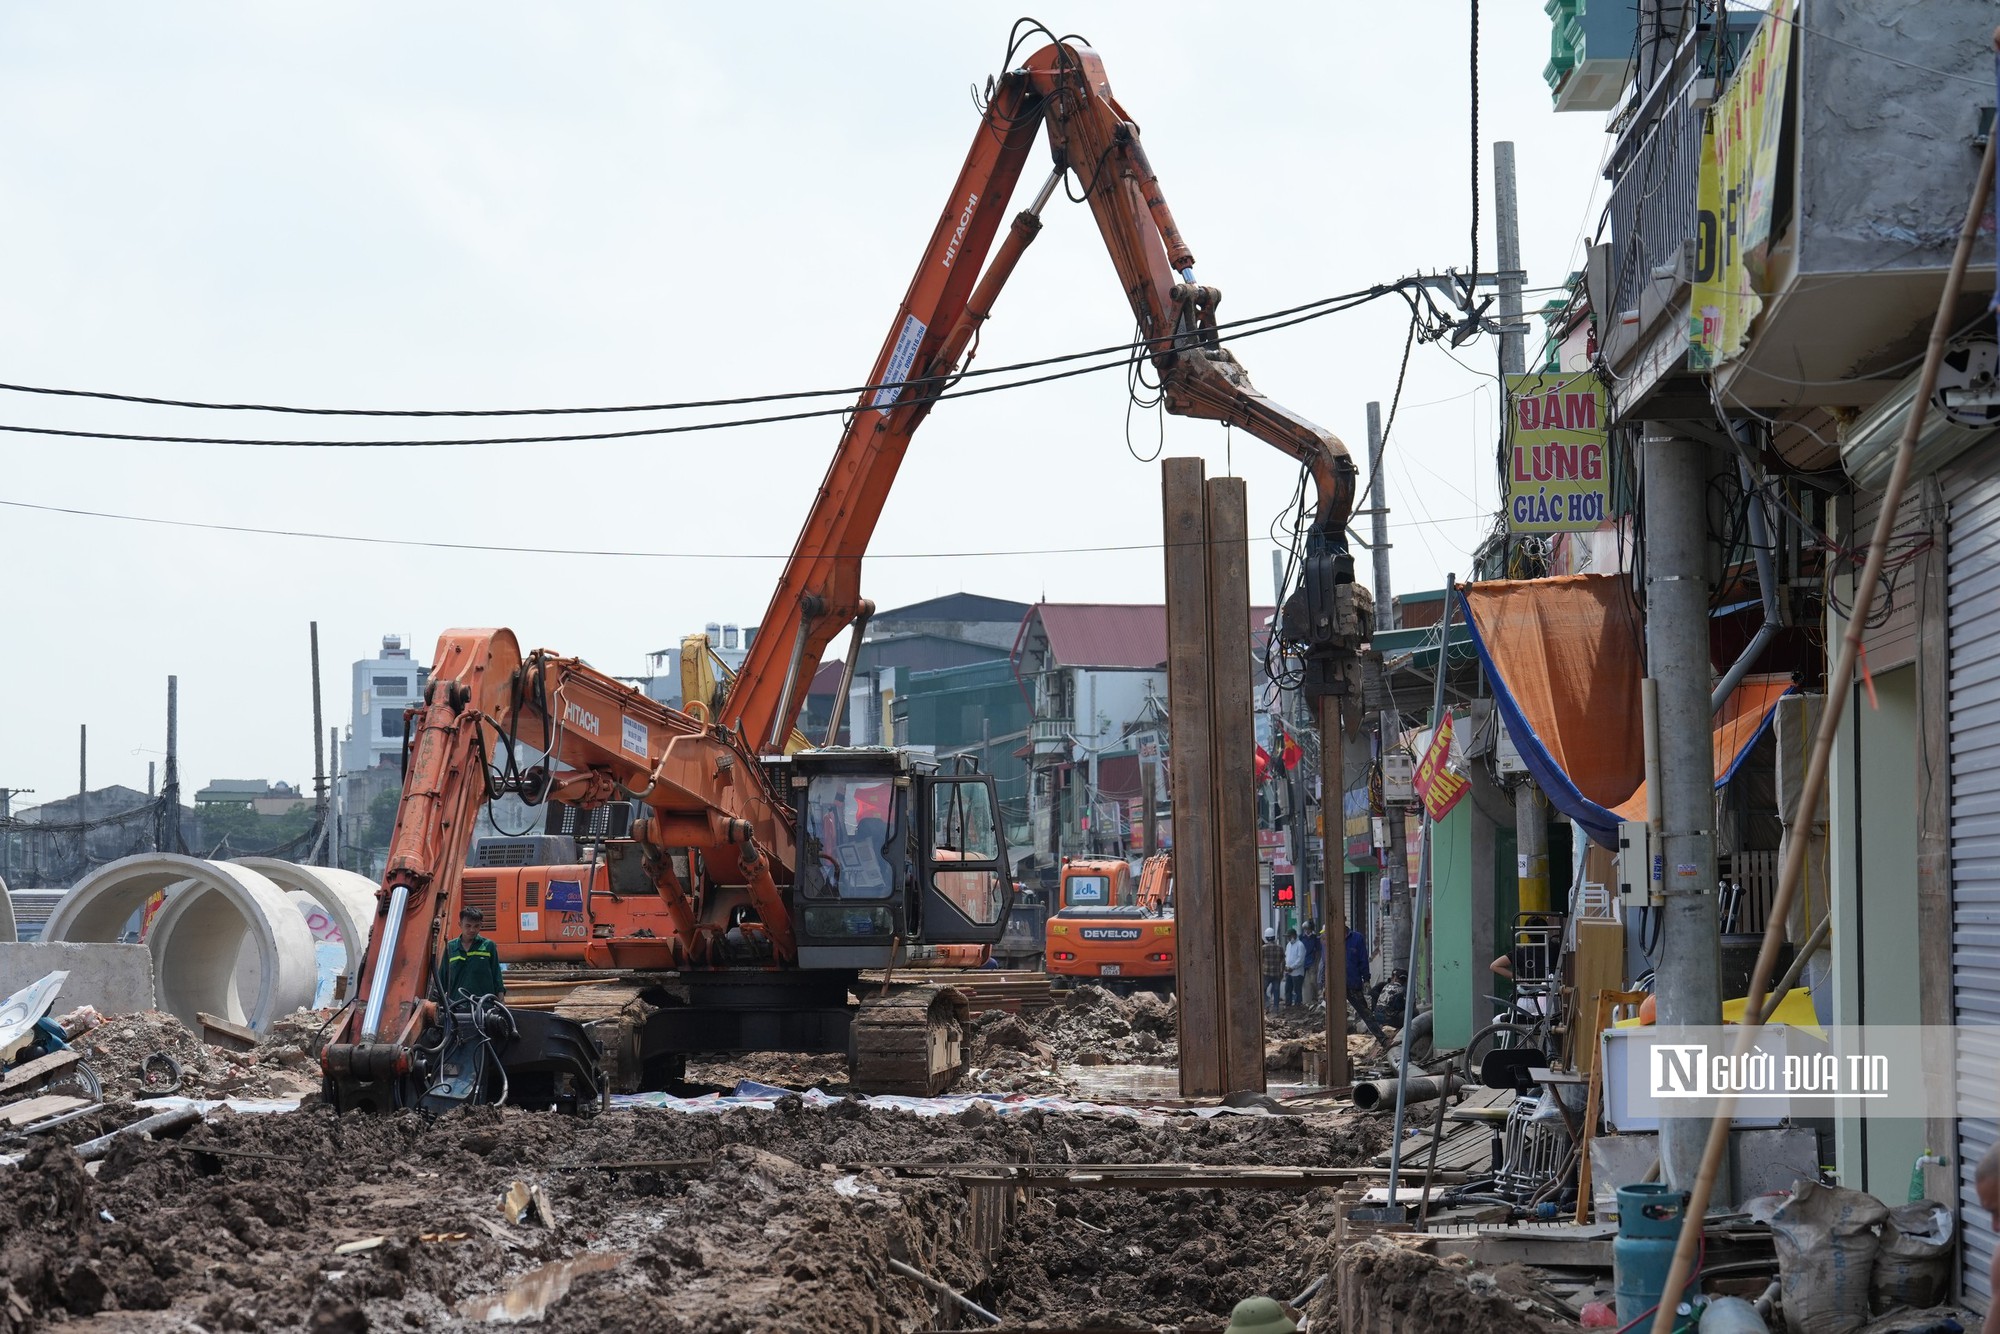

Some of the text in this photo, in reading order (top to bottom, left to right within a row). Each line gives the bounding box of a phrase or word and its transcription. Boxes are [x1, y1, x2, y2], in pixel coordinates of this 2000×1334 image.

[942, 193, 978, 268] HITACHI
[1514, 441, 1602, 482] LƯNG
[1513, 487, 1604, 523] GIÁC HƠI
[566, 700, 600, 737] HITACHI
[562, 925, 586, 937] 470
[1084, 930, 1138, 938] DEVELON
